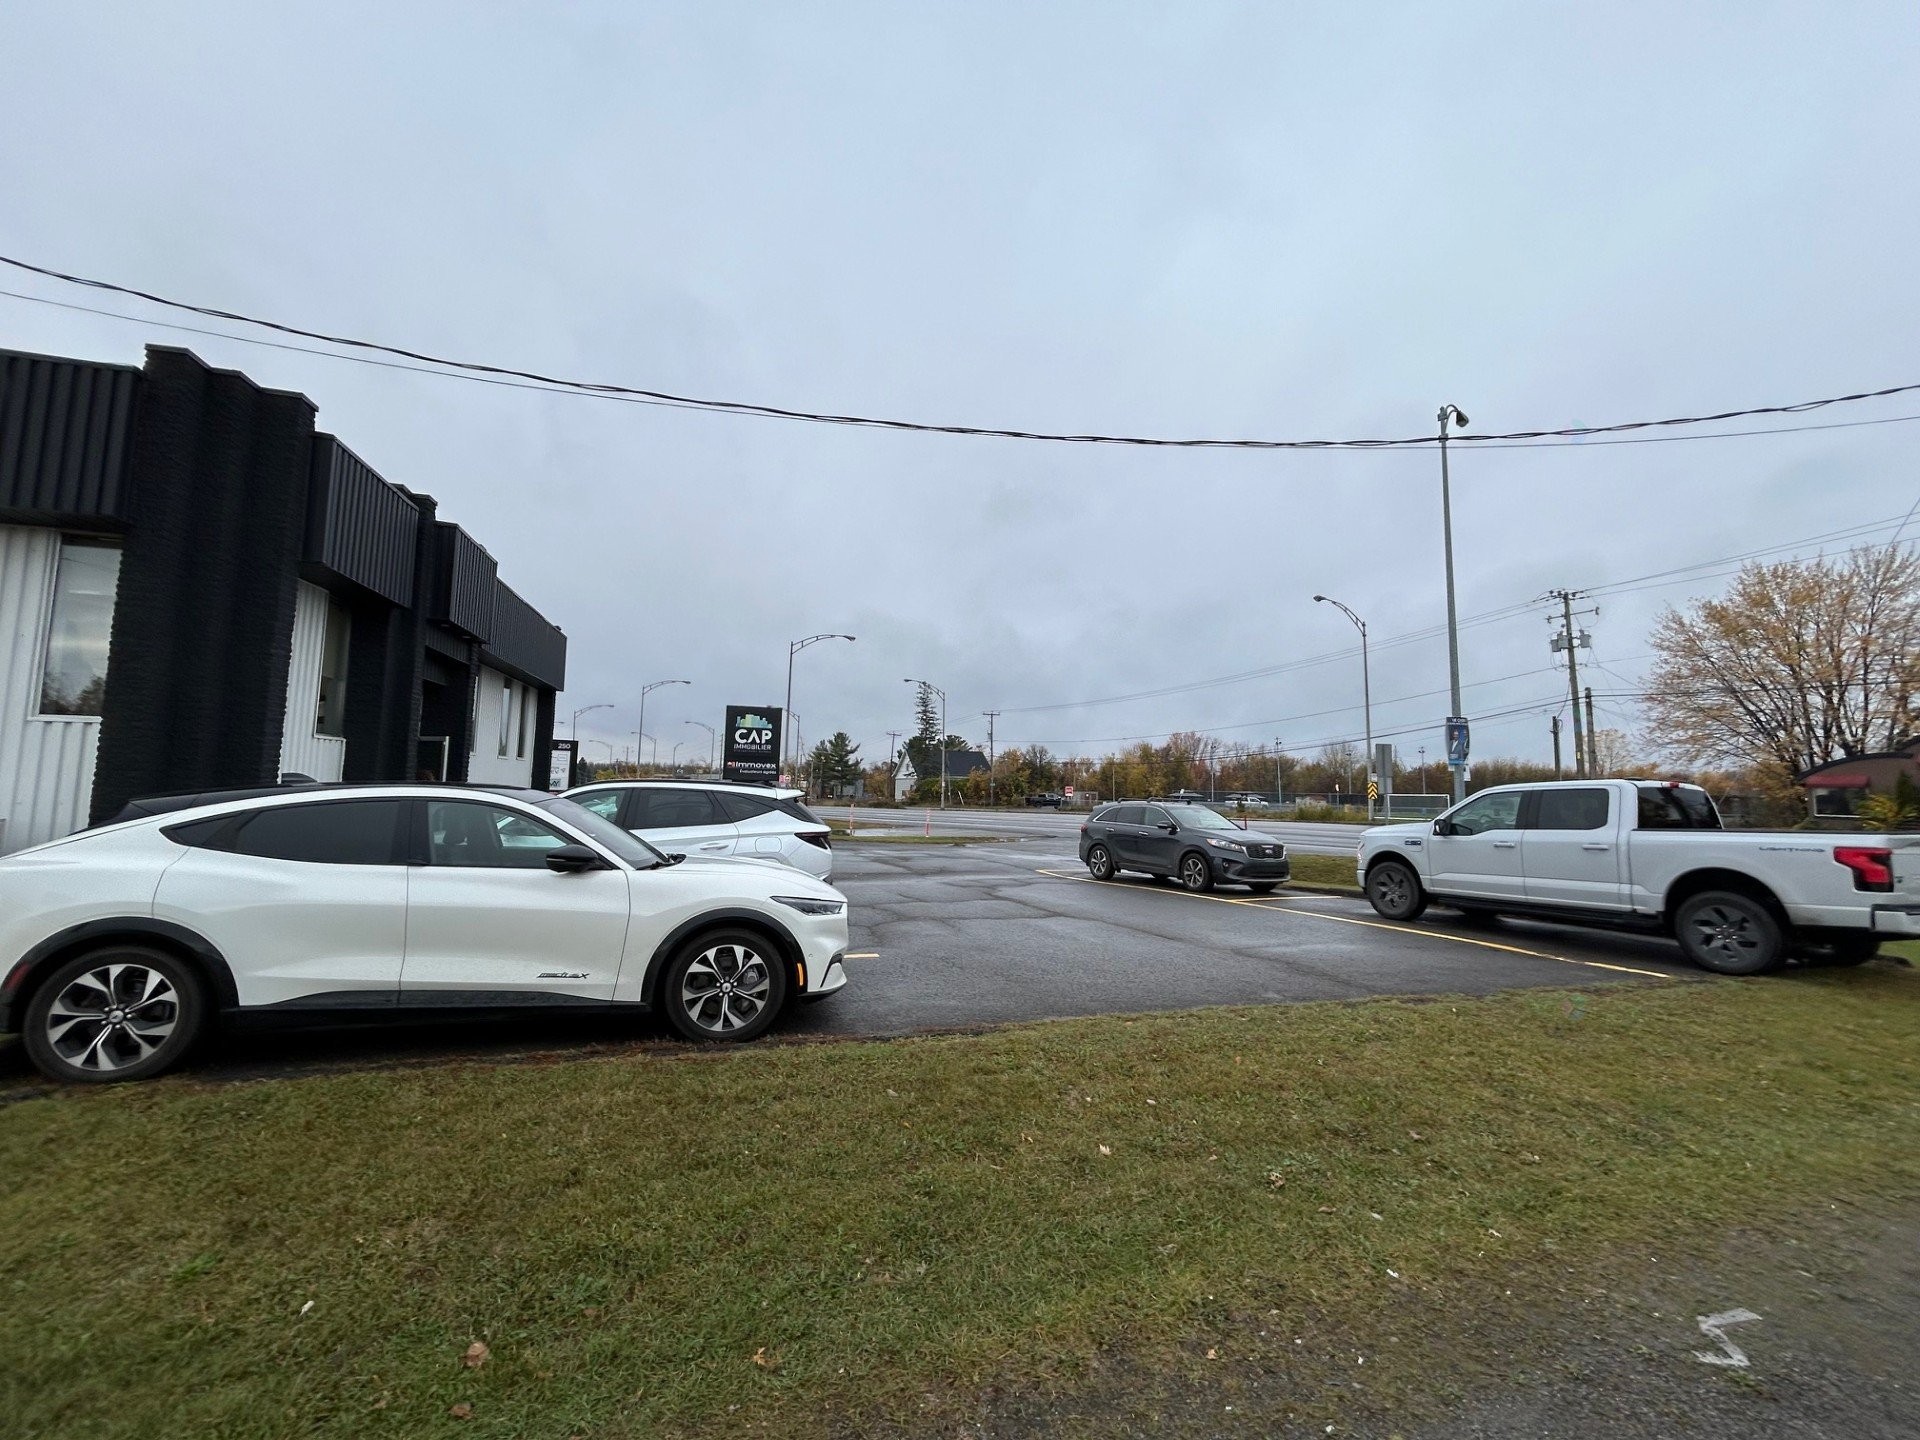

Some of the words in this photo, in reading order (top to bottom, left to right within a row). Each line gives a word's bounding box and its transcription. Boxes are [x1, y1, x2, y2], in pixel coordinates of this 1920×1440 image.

[734, 728, 772, 744] CAP
[557, 742, 571, 750] 250
[733, 743, 772, 751] IMMOBILIER
